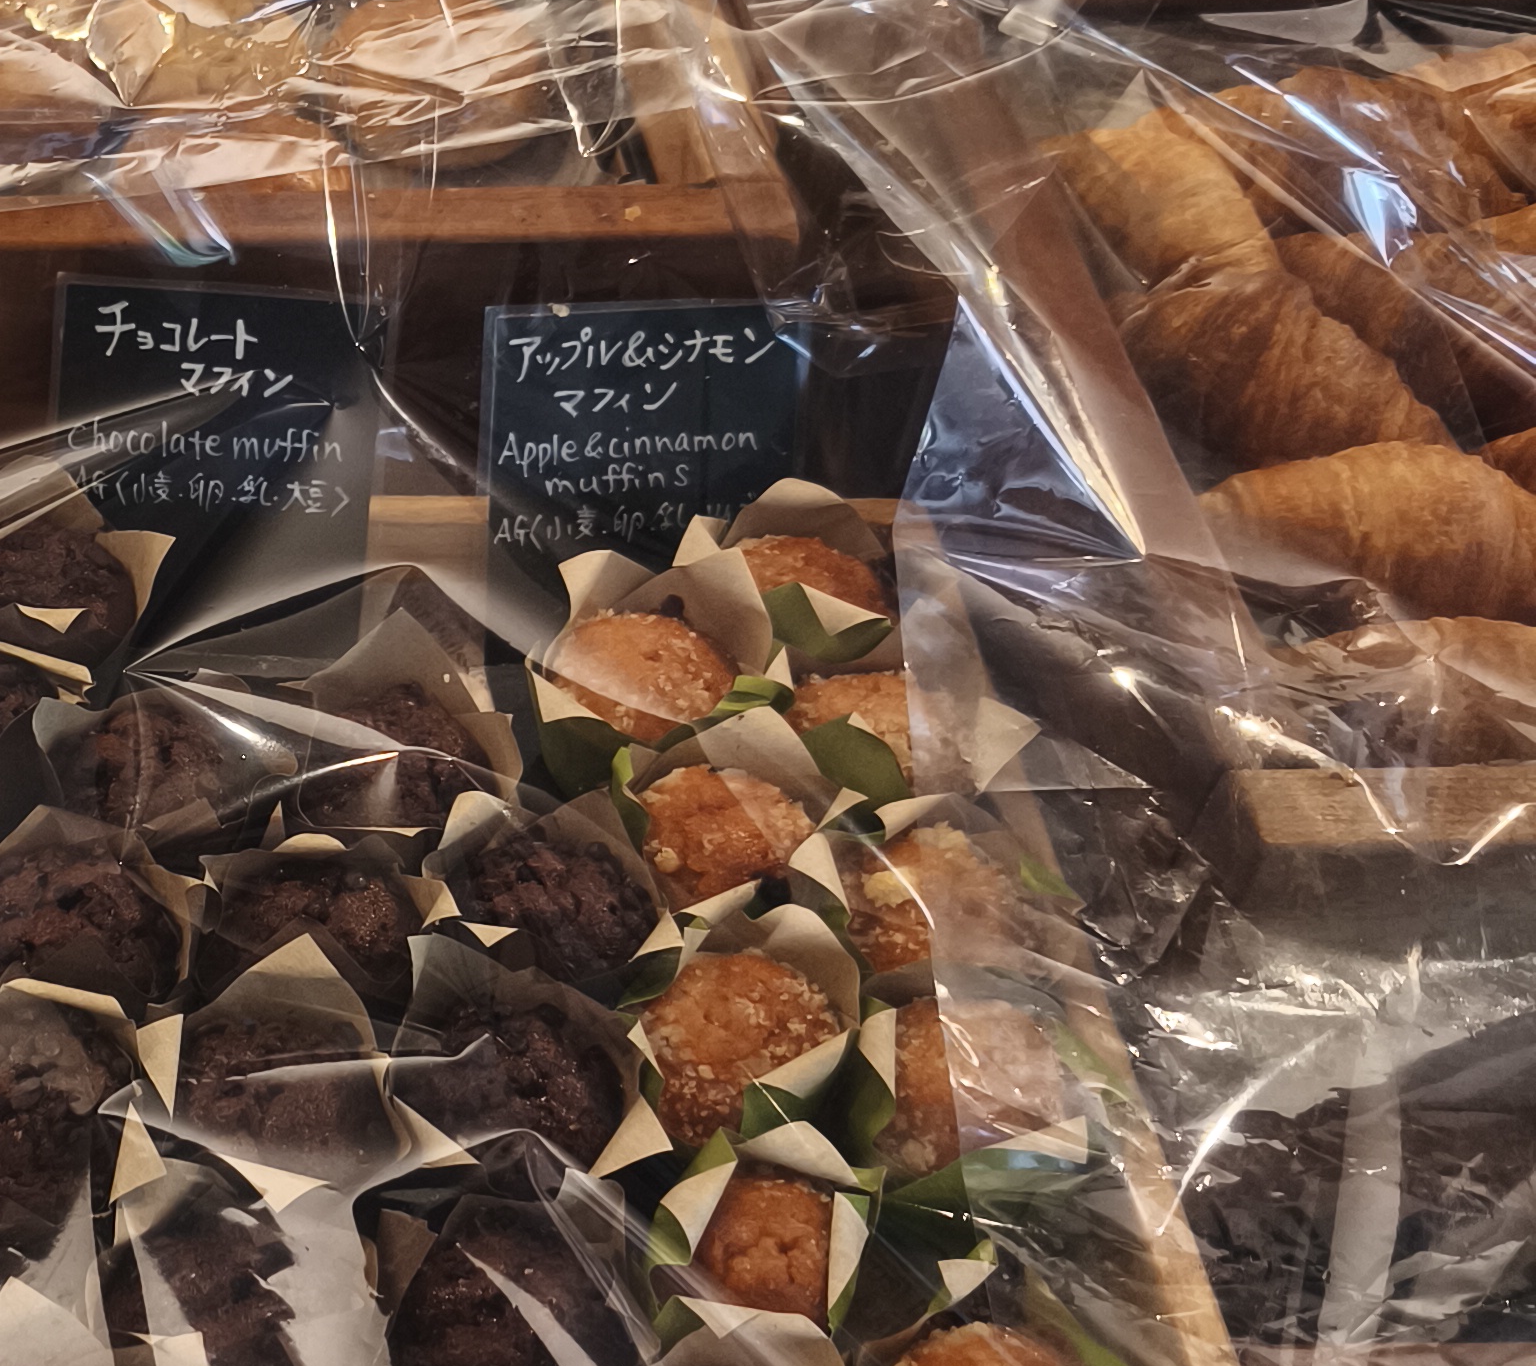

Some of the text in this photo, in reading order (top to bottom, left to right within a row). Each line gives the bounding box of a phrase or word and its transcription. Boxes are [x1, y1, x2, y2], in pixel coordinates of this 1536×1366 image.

[94, 300, 259, 360] チョコレート
[180, 362, 294, 398] マフィン
[553, 381, 678, 418] マフィン
[66, 415, 344, 462] Chocolate muffin
